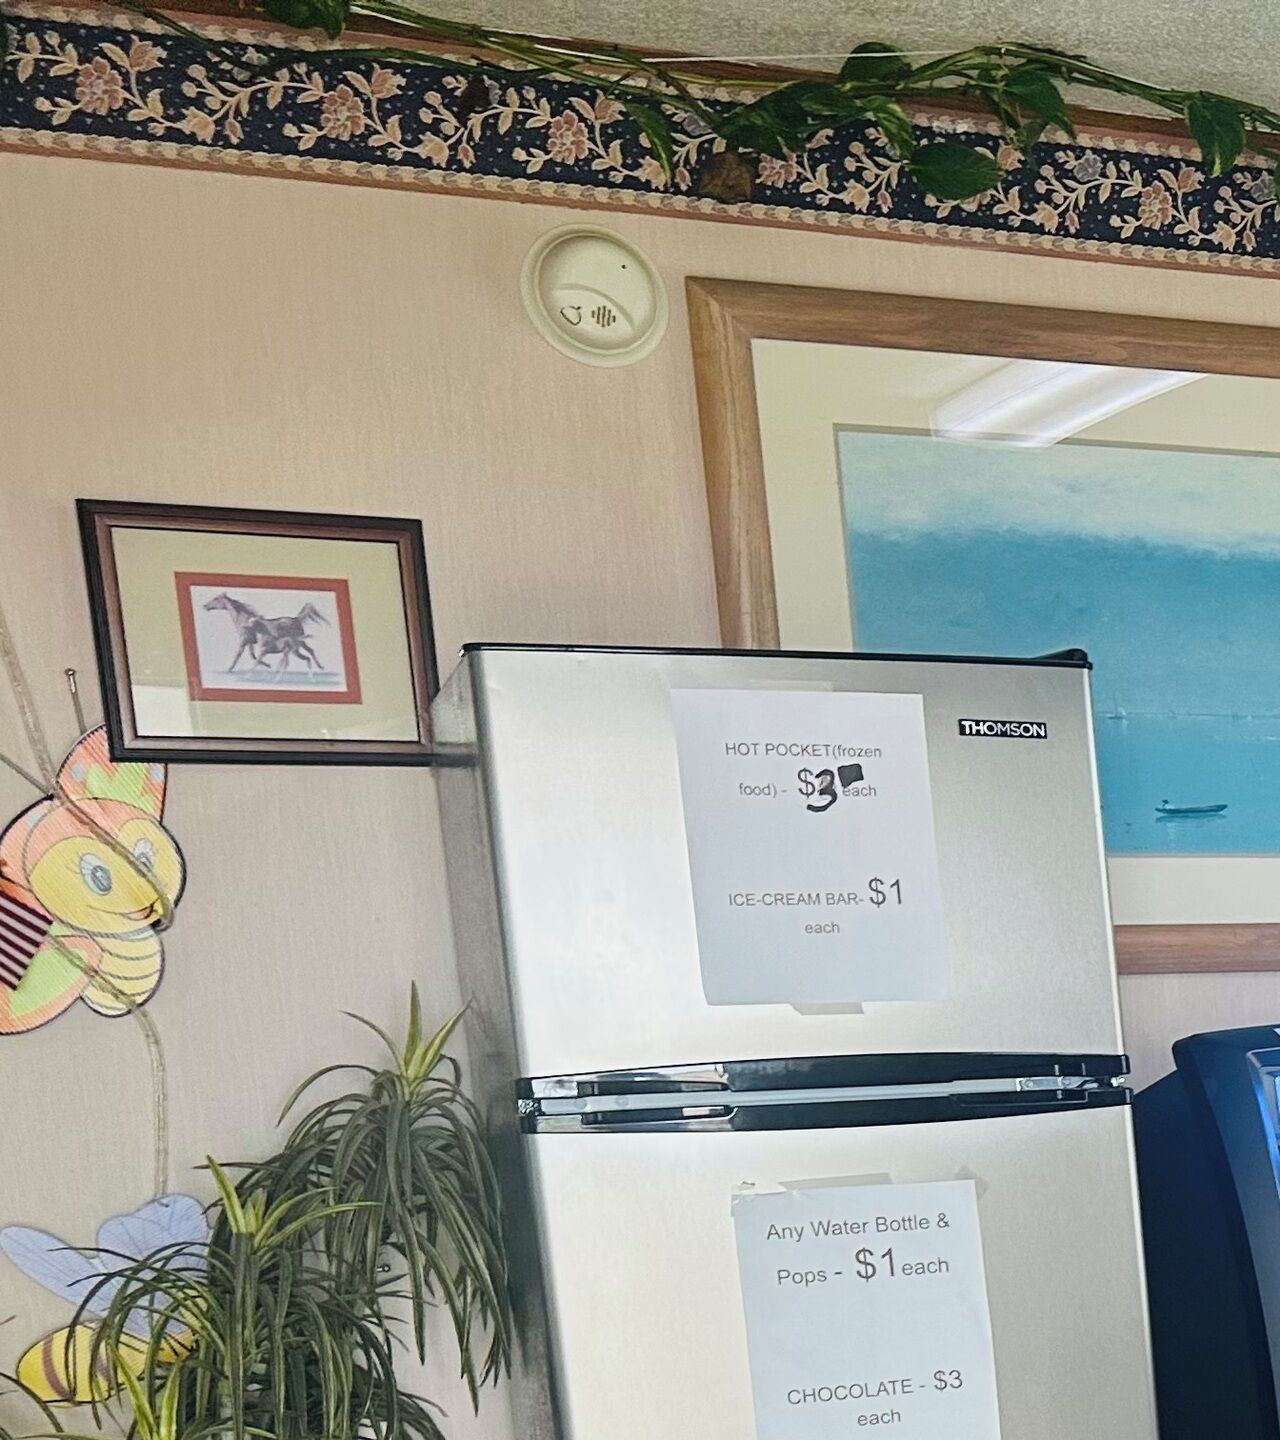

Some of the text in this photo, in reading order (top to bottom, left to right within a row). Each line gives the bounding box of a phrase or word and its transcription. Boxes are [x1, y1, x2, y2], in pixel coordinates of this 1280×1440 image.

[962, 720, 1046, 738] THOMSON
[725, 742, 759, 757] HOT
[738, 782, 777, 799] food)
[841, 784, 877, 798] each
[728, 891, 821, 907] ICE-CREAM
[868, 877, 903, 907] $1
[804, 920, 841, 935] each
[766, 1212, 950, 1242] Any Water Bottle &
[777, 1268, 828, 1287] Pops
[855, 1247, 895, 1282] $1
[901, 1257, 950, 1276] each
[787, 1378, 914, 1405] CHOCOLATE
[933, 1369, 963, 1391] $3
[857, 1409, 901, 1427] each
